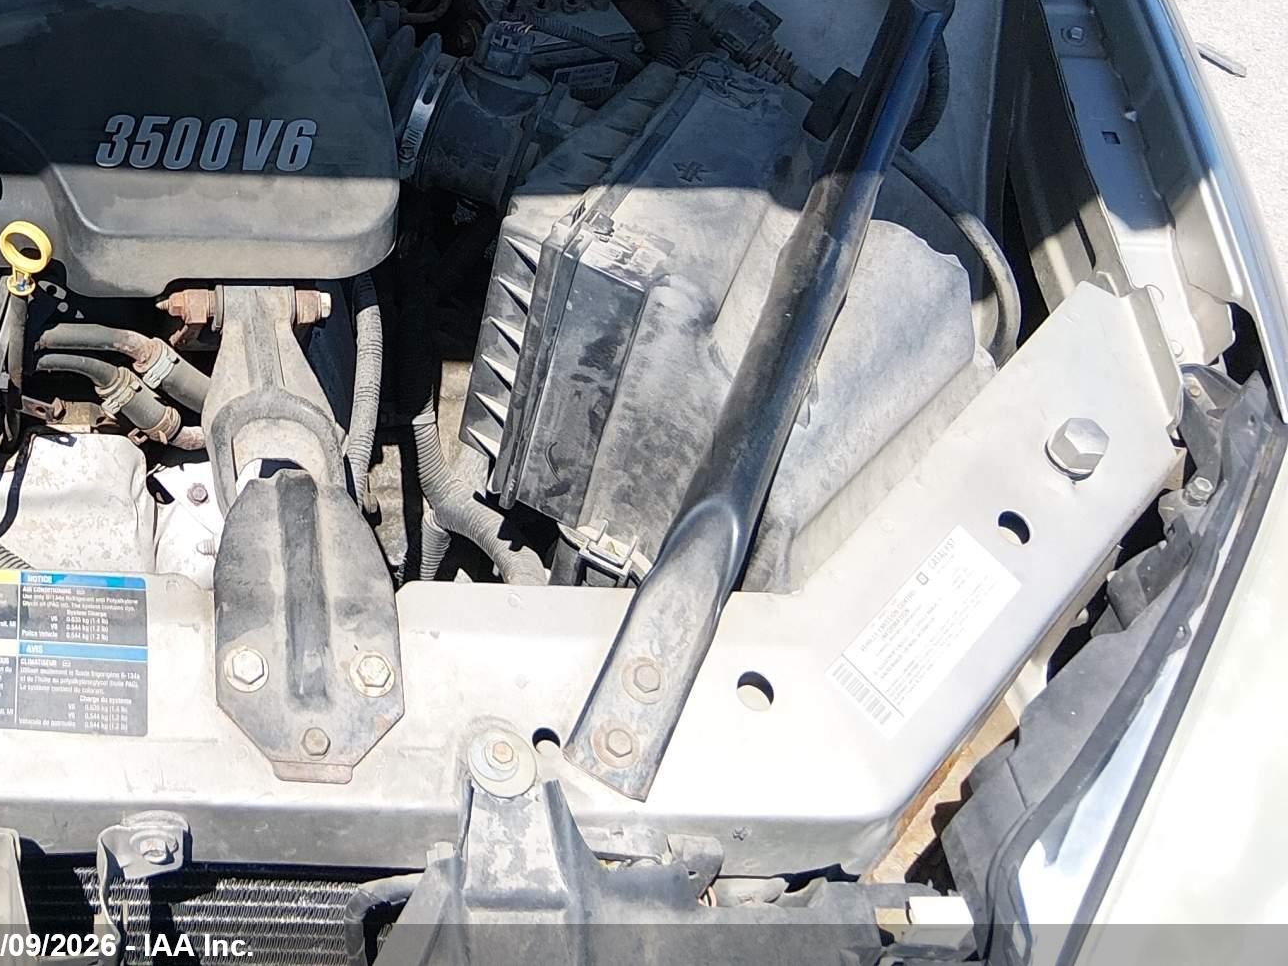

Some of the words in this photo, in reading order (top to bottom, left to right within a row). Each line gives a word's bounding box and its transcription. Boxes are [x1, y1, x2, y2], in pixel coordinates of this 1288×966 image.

[95, 114, 238, 171] 3500
[242, 118, 318, 172] V6
[27, 575, 52, 583] NOTICE
[25, 645, 43, 654] AVIS
